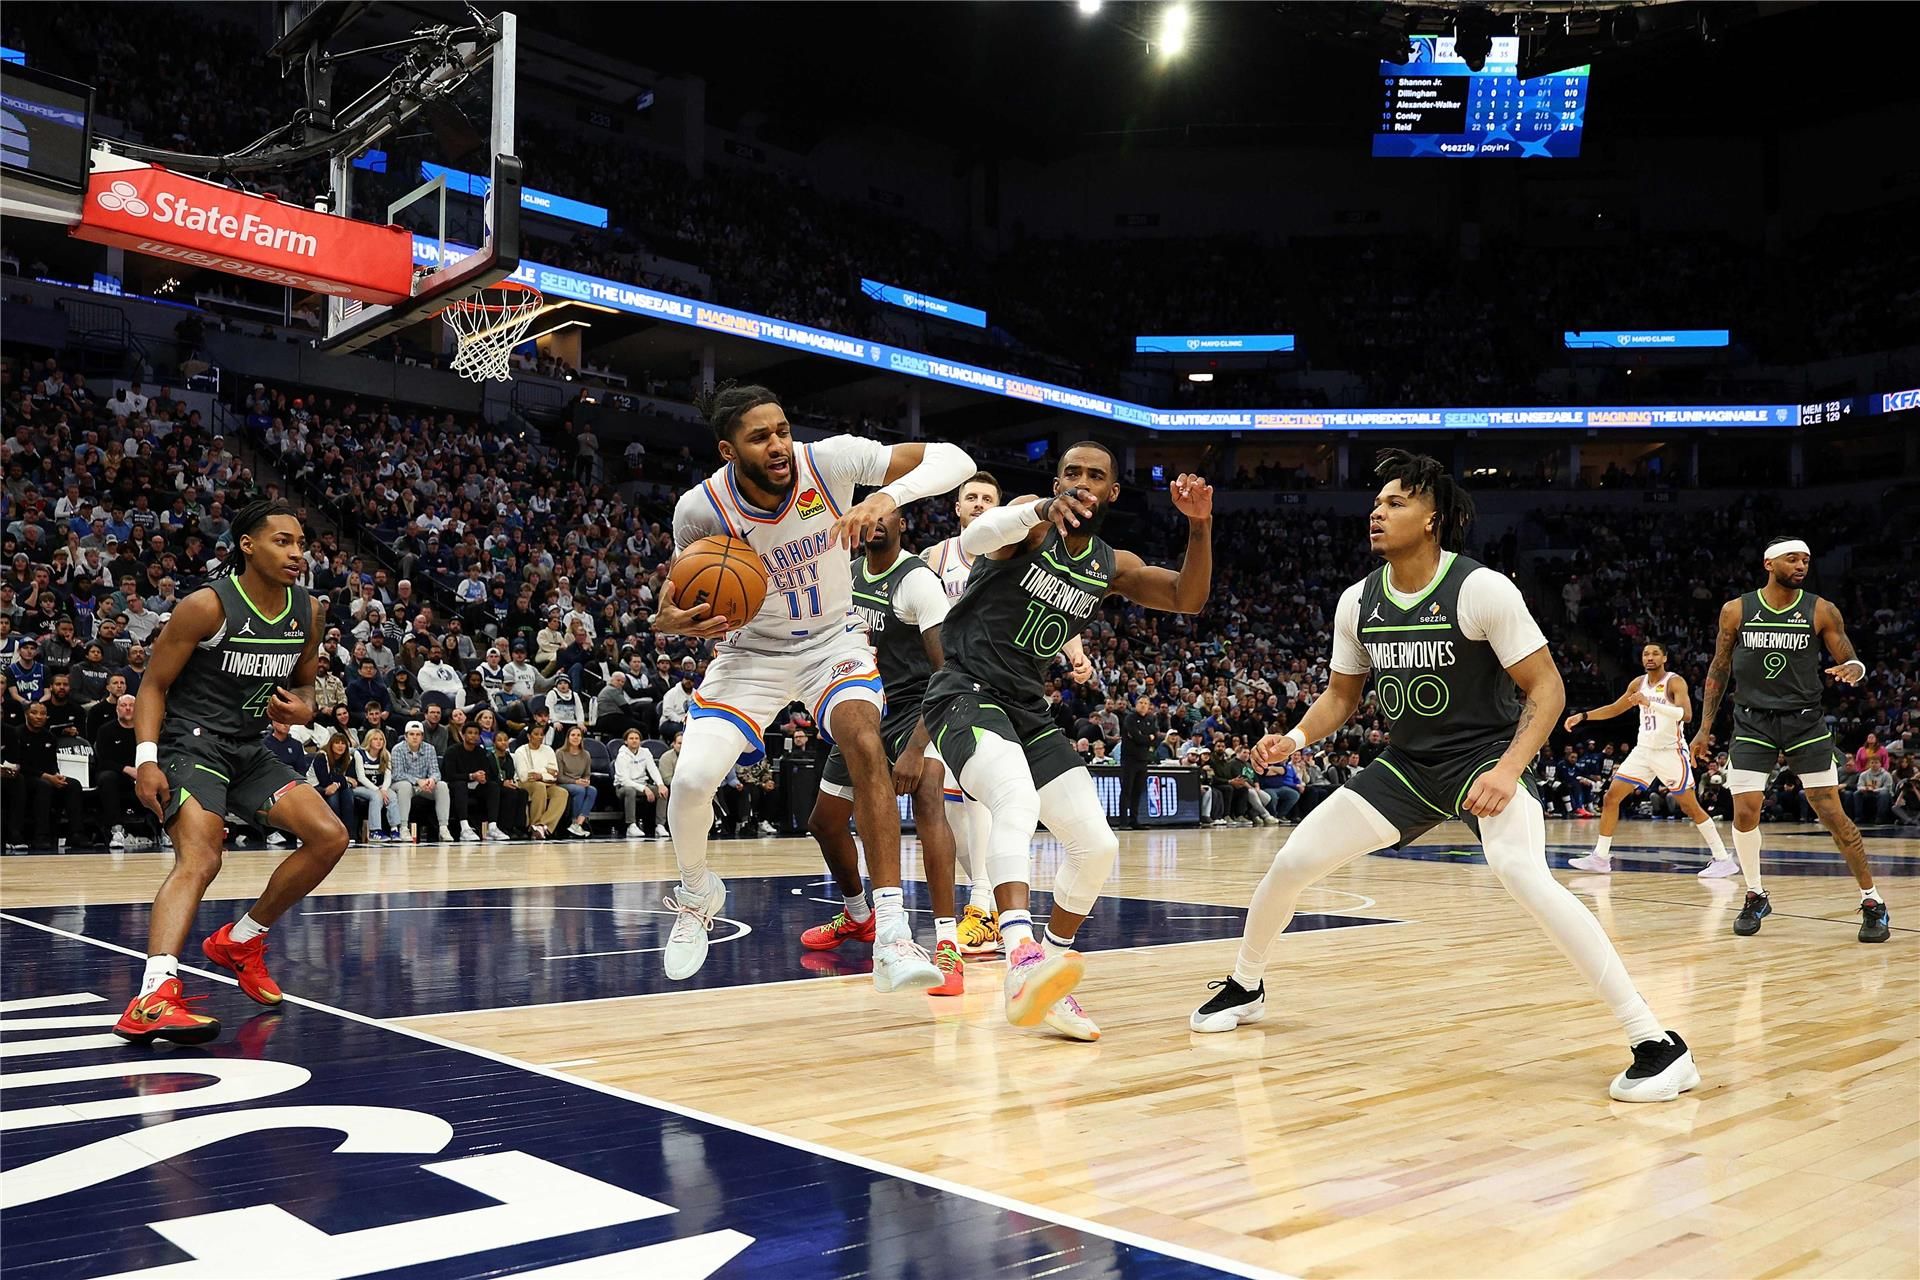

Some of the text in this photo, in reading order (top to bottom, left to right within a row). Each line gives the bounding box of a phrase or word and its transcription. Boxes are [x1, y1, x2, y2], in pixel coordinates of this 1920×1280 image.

[1398, 90, 1437, 99] Dillingham
[1396, 112, 1422, 122] Conley
[540, 272, 591, 294] SEEING
[591, 284, 618, 303] THE
[619, 289, 693, 318] UNSEEABLE
[697, 306, 760, 332] IMAGINING
[890, 352, 928, 372] CURING
[1171, 414, 1252, 426] UNTREATABLE
[1254, 414, 1323, 425] PREDICTING
[1350, 413, 1440, 424] UNPREDICTABLE
[1444, 413, 1488, 424] SEEING
[1488, 412, 1514, 424] THE
[1514, 412, 1584, 424] UNSEEABLE
[1802, 401, 1840, 416] MEM 123
[1802, 412, 1840, 426] CLE 129
[1843, 404, 1850, 415] 4
[760, 528, 834, 576] LAHOM
[772, 561, 820, 590] CITY
[1085, 568, 1108, 580] sezzle
[780, 584, 822, 620] 11
[1020, 562, 1100, 620] TIMBERWOLVES
[1014, 600, 1068, 658] 10
[1420, 614, 1447, 623] sezzle
[1742, 632, 1810, 652] TIMBERWOLVES
[1364, 641, 1456, 672] TIMBERWOLVES
[1764, 652, 1786, 679] 9
[242, 682, 274, 718] 4
[1378, 674, 1450, 720] 00
[1644, 716, 1656, 730] 21
